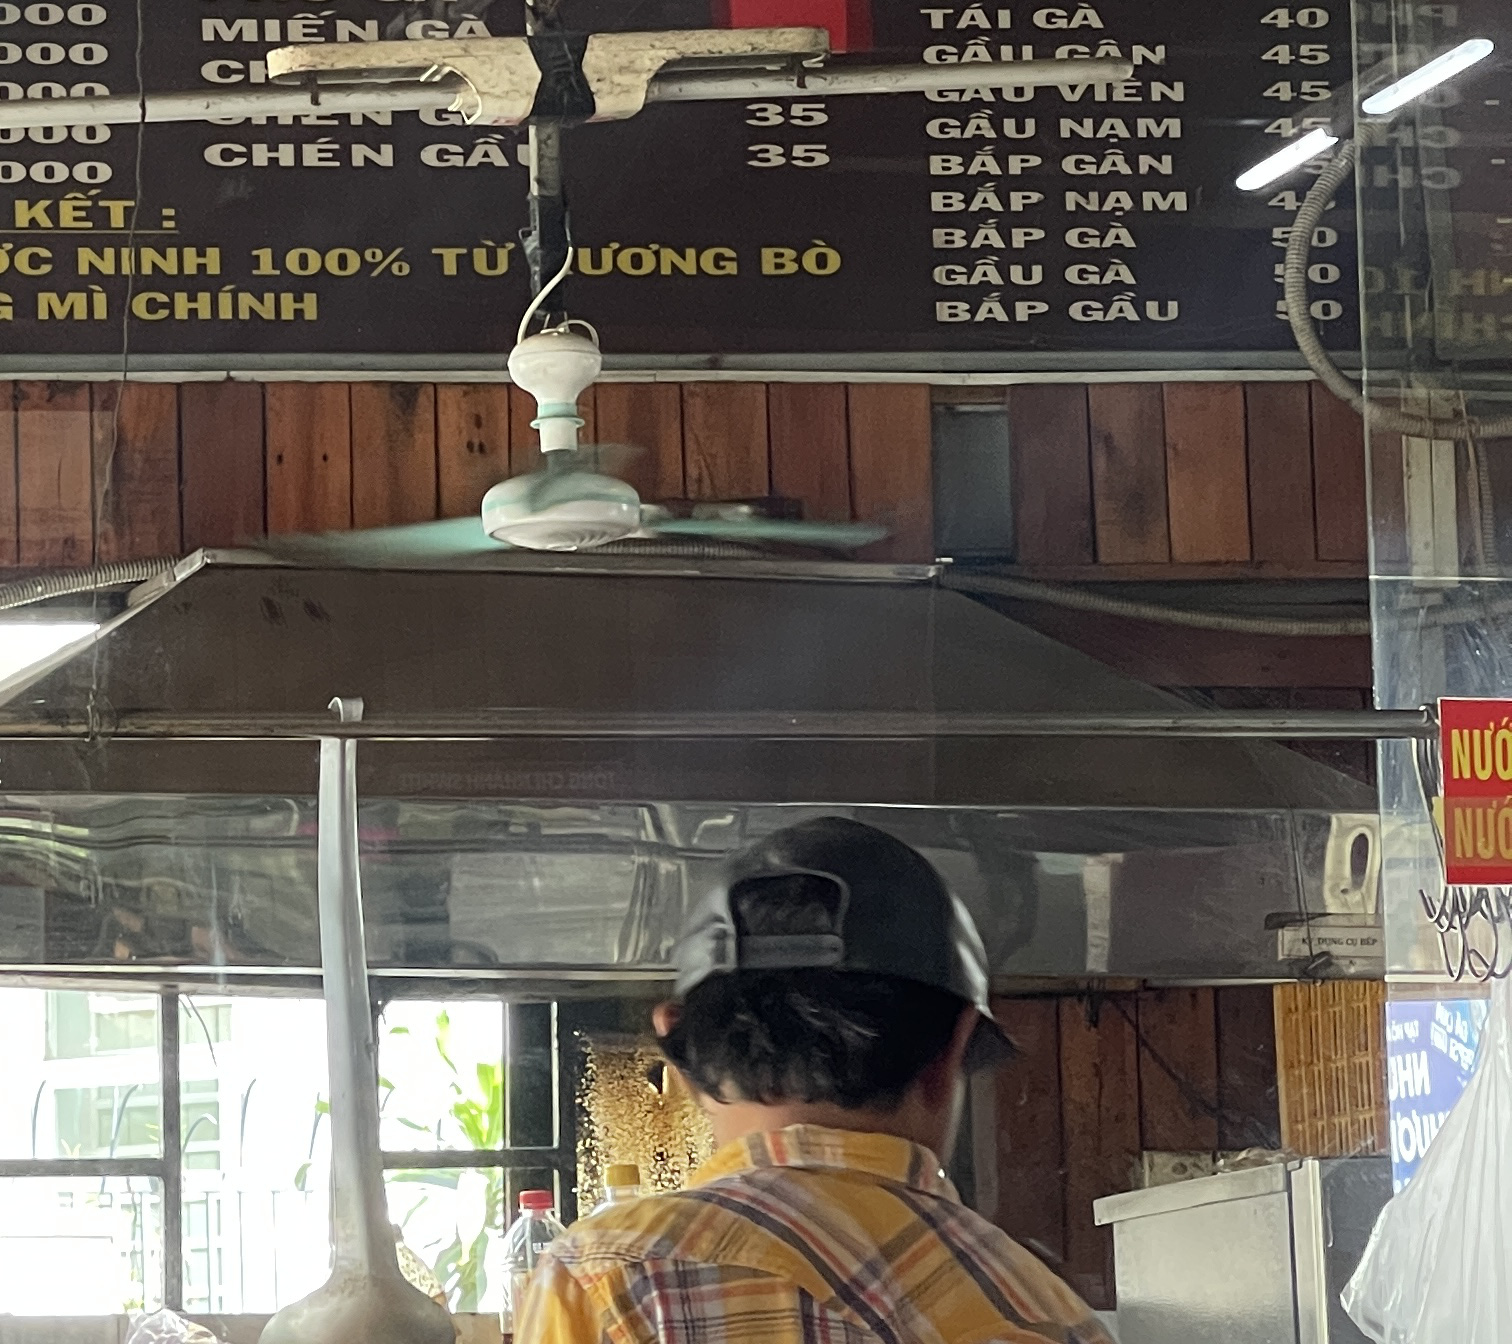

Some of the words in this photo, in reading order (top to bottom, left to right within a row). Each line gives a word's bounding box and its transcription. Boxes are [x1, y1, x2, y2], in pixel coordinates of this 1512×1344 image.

[202, 10, 379, 42] MIẾN
[405, 14, 492, 39] GÀ
[920, 2, 1011, 29] TÁI
[1032, 2, 1104, 29] GÀ
[1260, 8, 1329, 28] 40
[1261, 44, 1330, 65] 45
[1262, 81, 1331, 101] 45
[746, 103, 829, 126] 35
[926, 108, 1036, 139] GẦU
[1060, 118, 1181, 143] NẠM
[204, 137, 394, 167] CHÉN
[746, 144, 830, 167] 35
[929, 145, 1042, 175] BẮP
[1061, 148, 1173, 175] GÂN
[14, 189, 136, 228] KẾT
[930, 182, 1045, 212] BẮP
[1065, 191, 1187, 216] NẠM
[932, 219, 1045, 249] BẮP
[1064, 221, 1136, 248] GÀ
[78, 247, 221, 276] NINH
[252, 246, 410, 277] 100%
[432, 239, 516, 276] TỪ
[570, 242, 738, 276] ƯƠNG
[761, 240, 841, 276] BÒ
[933, 255, 1043, 286] GẦU
[1064, 258, 1136, 285] GÀ
[37, 285, 108, 320] MÌ
[132, 285, 318, 321] CHÍNH
[935, 292, 1049, 322] BẮP
[1068, 291, 1179, 322] GẦU
